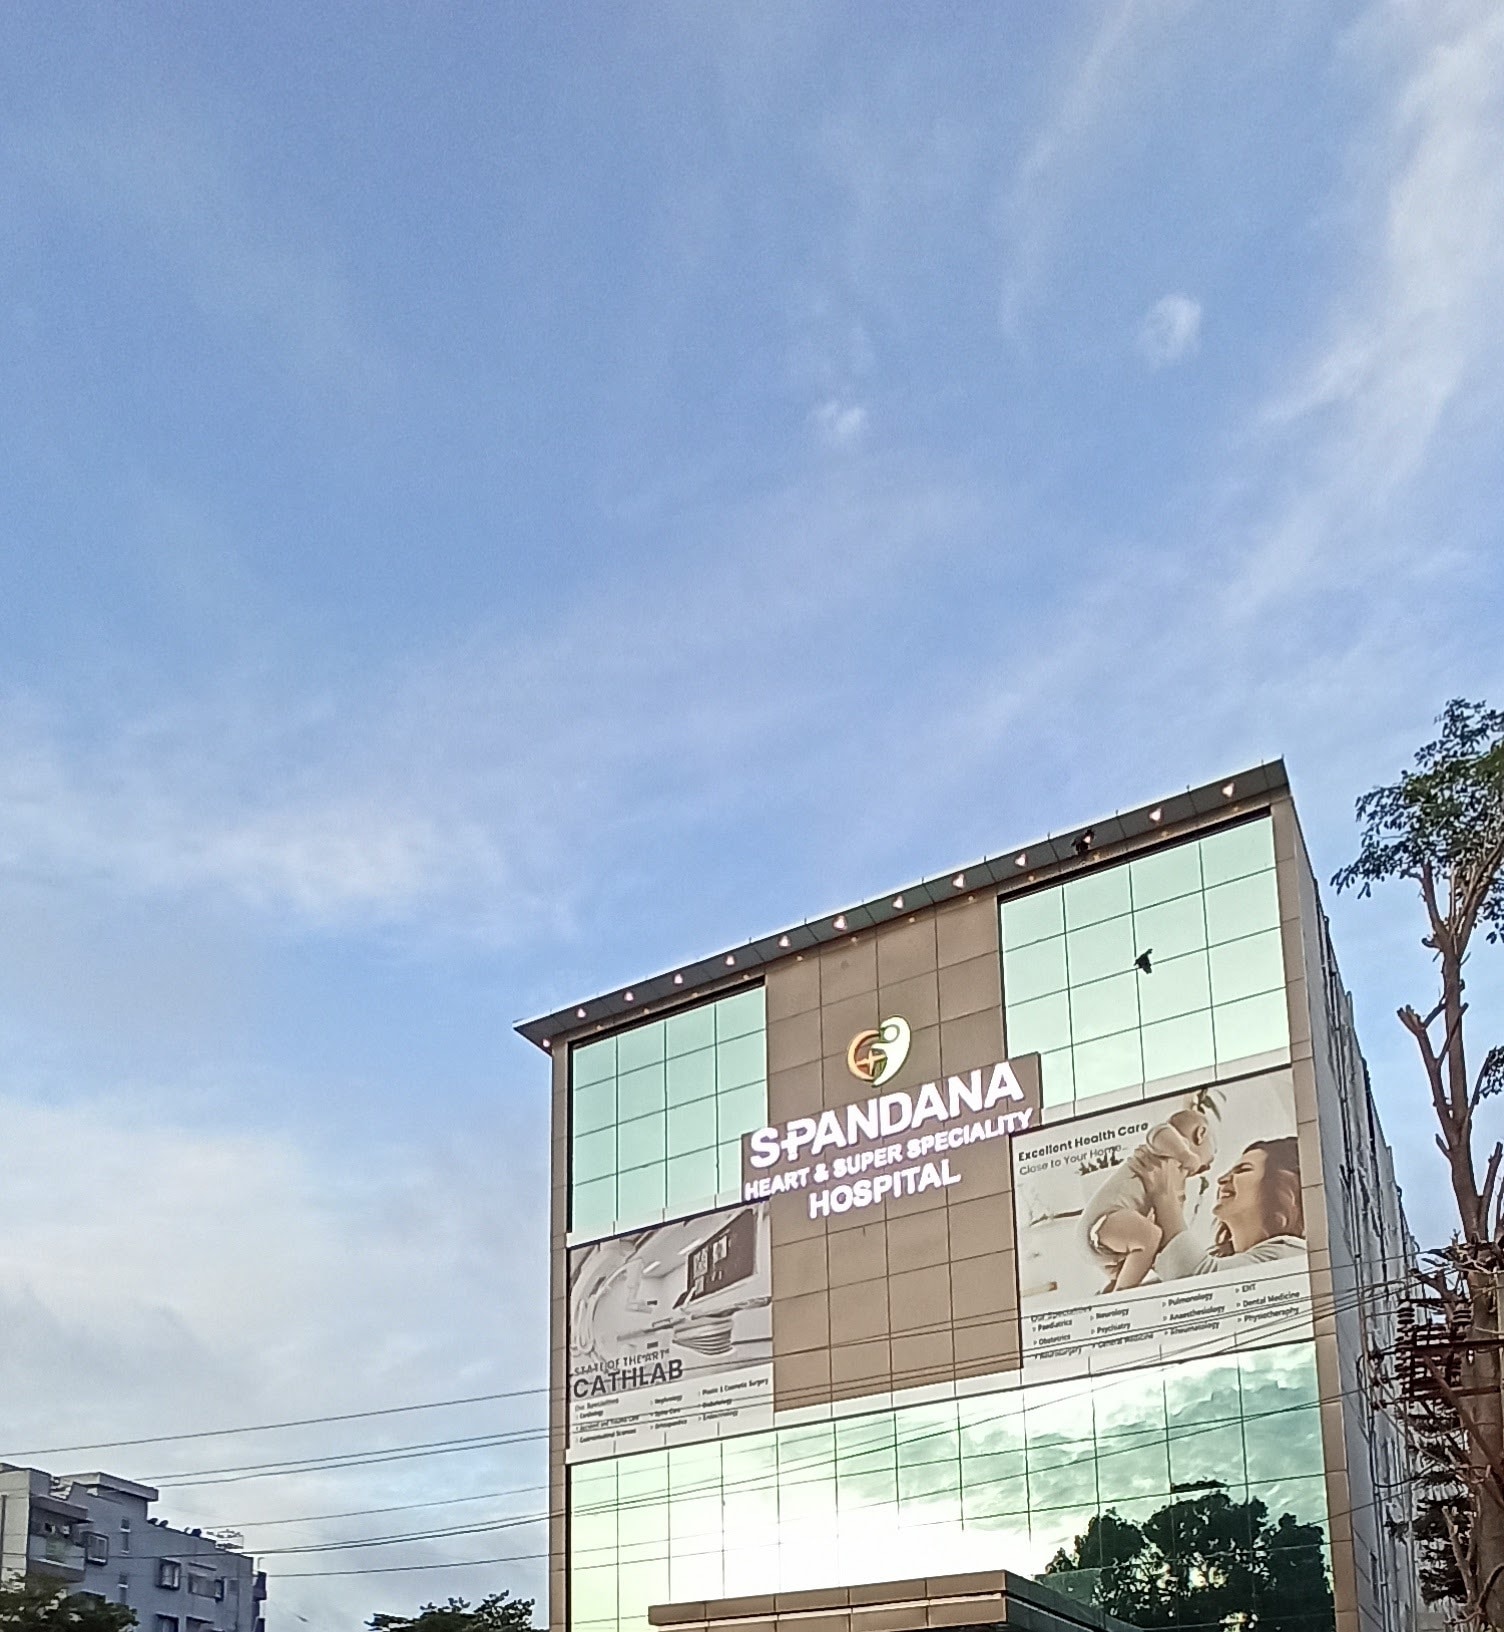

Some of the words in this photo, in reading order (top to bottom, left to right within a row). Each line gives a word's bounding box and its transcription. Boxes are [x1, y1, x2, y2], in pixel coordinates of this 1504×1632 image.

[744, 1167, 809, 1200] HEART
[813, 1160, 830, 1183] &
[833, 1143, 903, 1178] SUPER
[906, 1107, 1034, 1159] SPECIALITY
[1018, 1140, 1072, 1162] Excellent
[1075, 1129, 1115, 1148] Health
[1118, 1122, 1149, 1137] Care
[1019, 1162, 1049, 1175] Close
[1050, 1159, 1062, 1168] to
[1064, 1151, 1088, 1165] Your
[808, 1158, 962, 1219] HOSPITAL
[1168, 1293, 1213, 1306] Pulmonology
[1243, 1298, 1266, 1307] Dental
[1267, 1291, 1300, 1302] Medicine
[573, 1358, 683, 1398] CATHLAB
